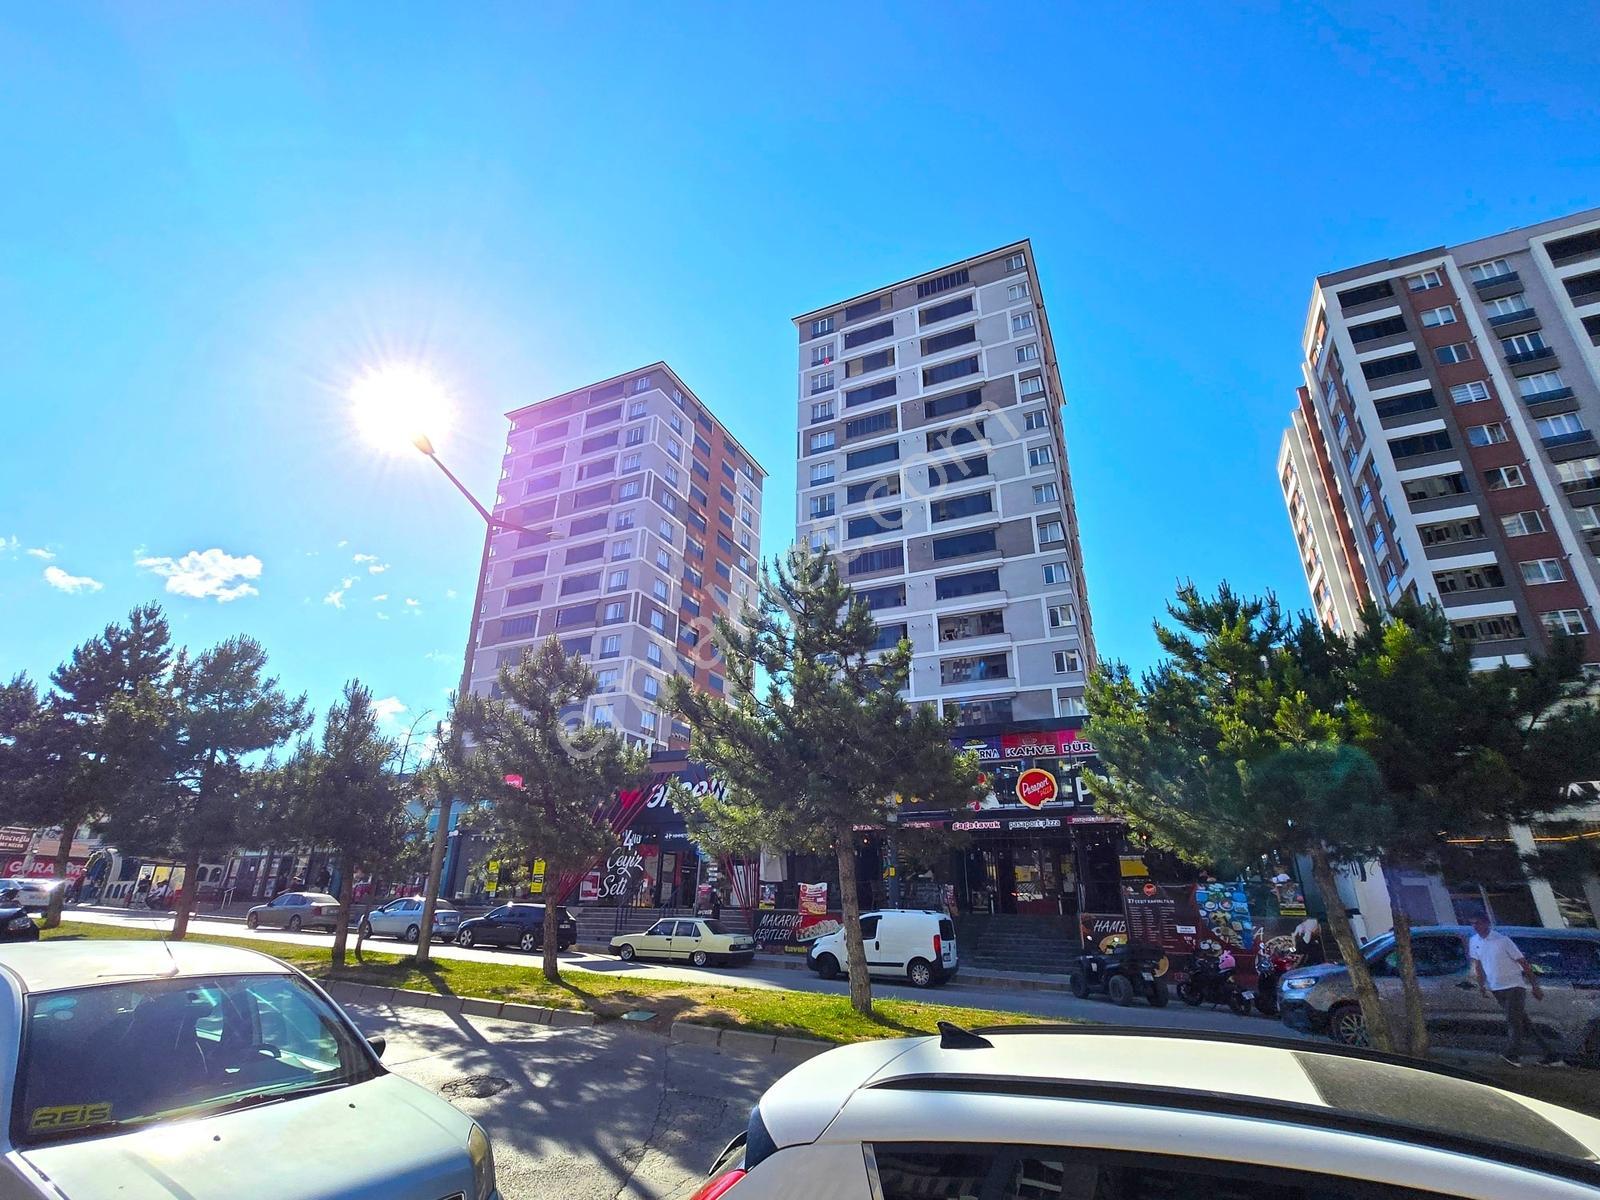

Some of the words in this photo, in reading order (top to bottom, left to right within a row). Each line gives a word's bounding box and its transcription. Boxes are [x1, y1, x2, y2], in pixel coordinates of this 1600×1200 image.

[1005, 745, 1056, 758] KAHVE
[606, 847, 644, 878] Çeyiz
[759, 914, 803, 927] MAKARNA
